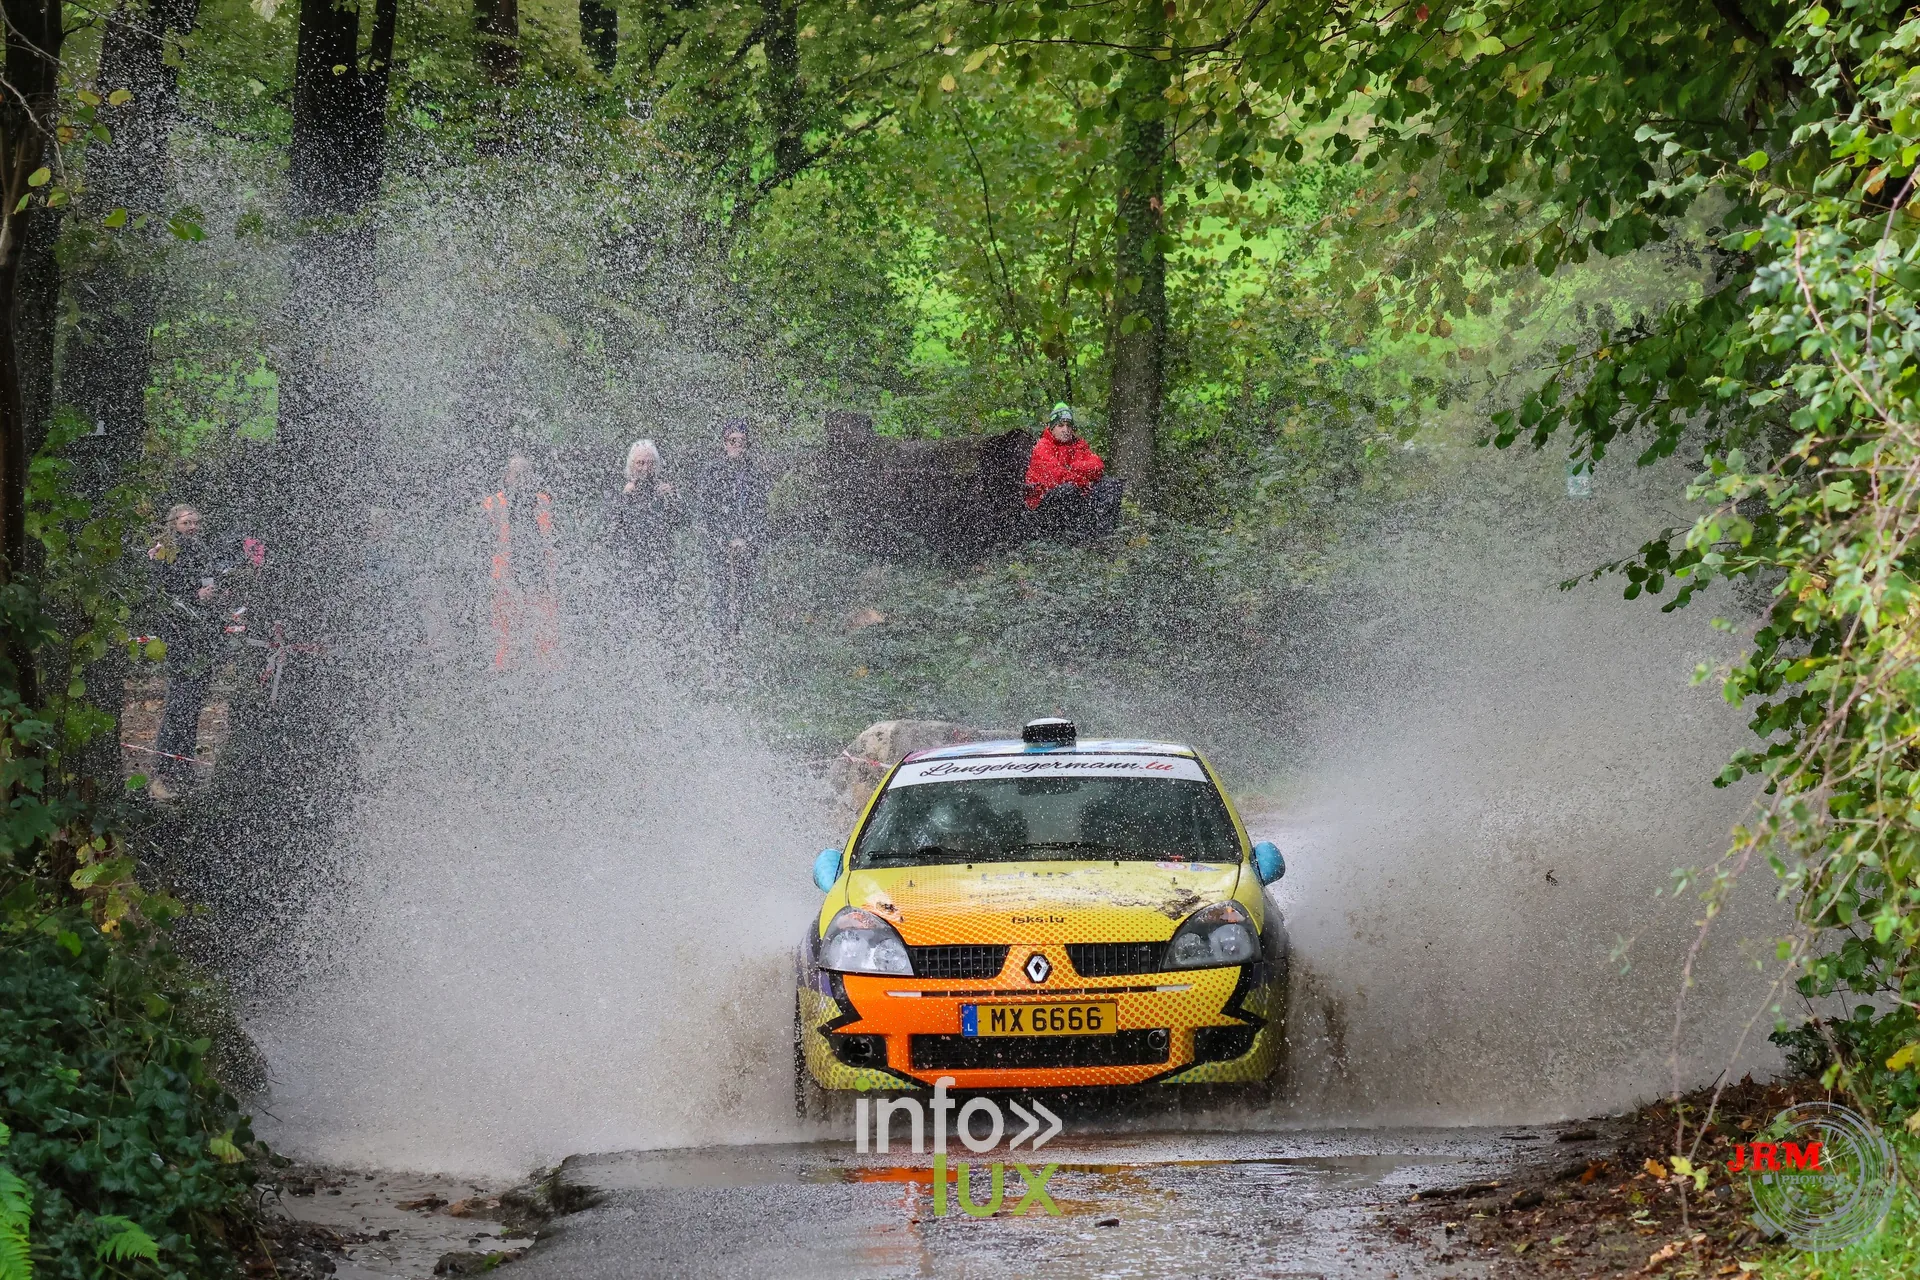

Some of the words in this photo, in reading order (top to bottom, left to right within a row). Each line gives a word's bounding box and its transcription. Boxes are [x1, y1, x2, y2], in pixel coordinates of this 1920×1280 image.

[1011, 915, 1065, 924] fsks.lu
[967, 1023, 973, 1032] L
[991, 1008, 1024, 1032] MX
[1032, 1006, 1101, 1032] 6666
